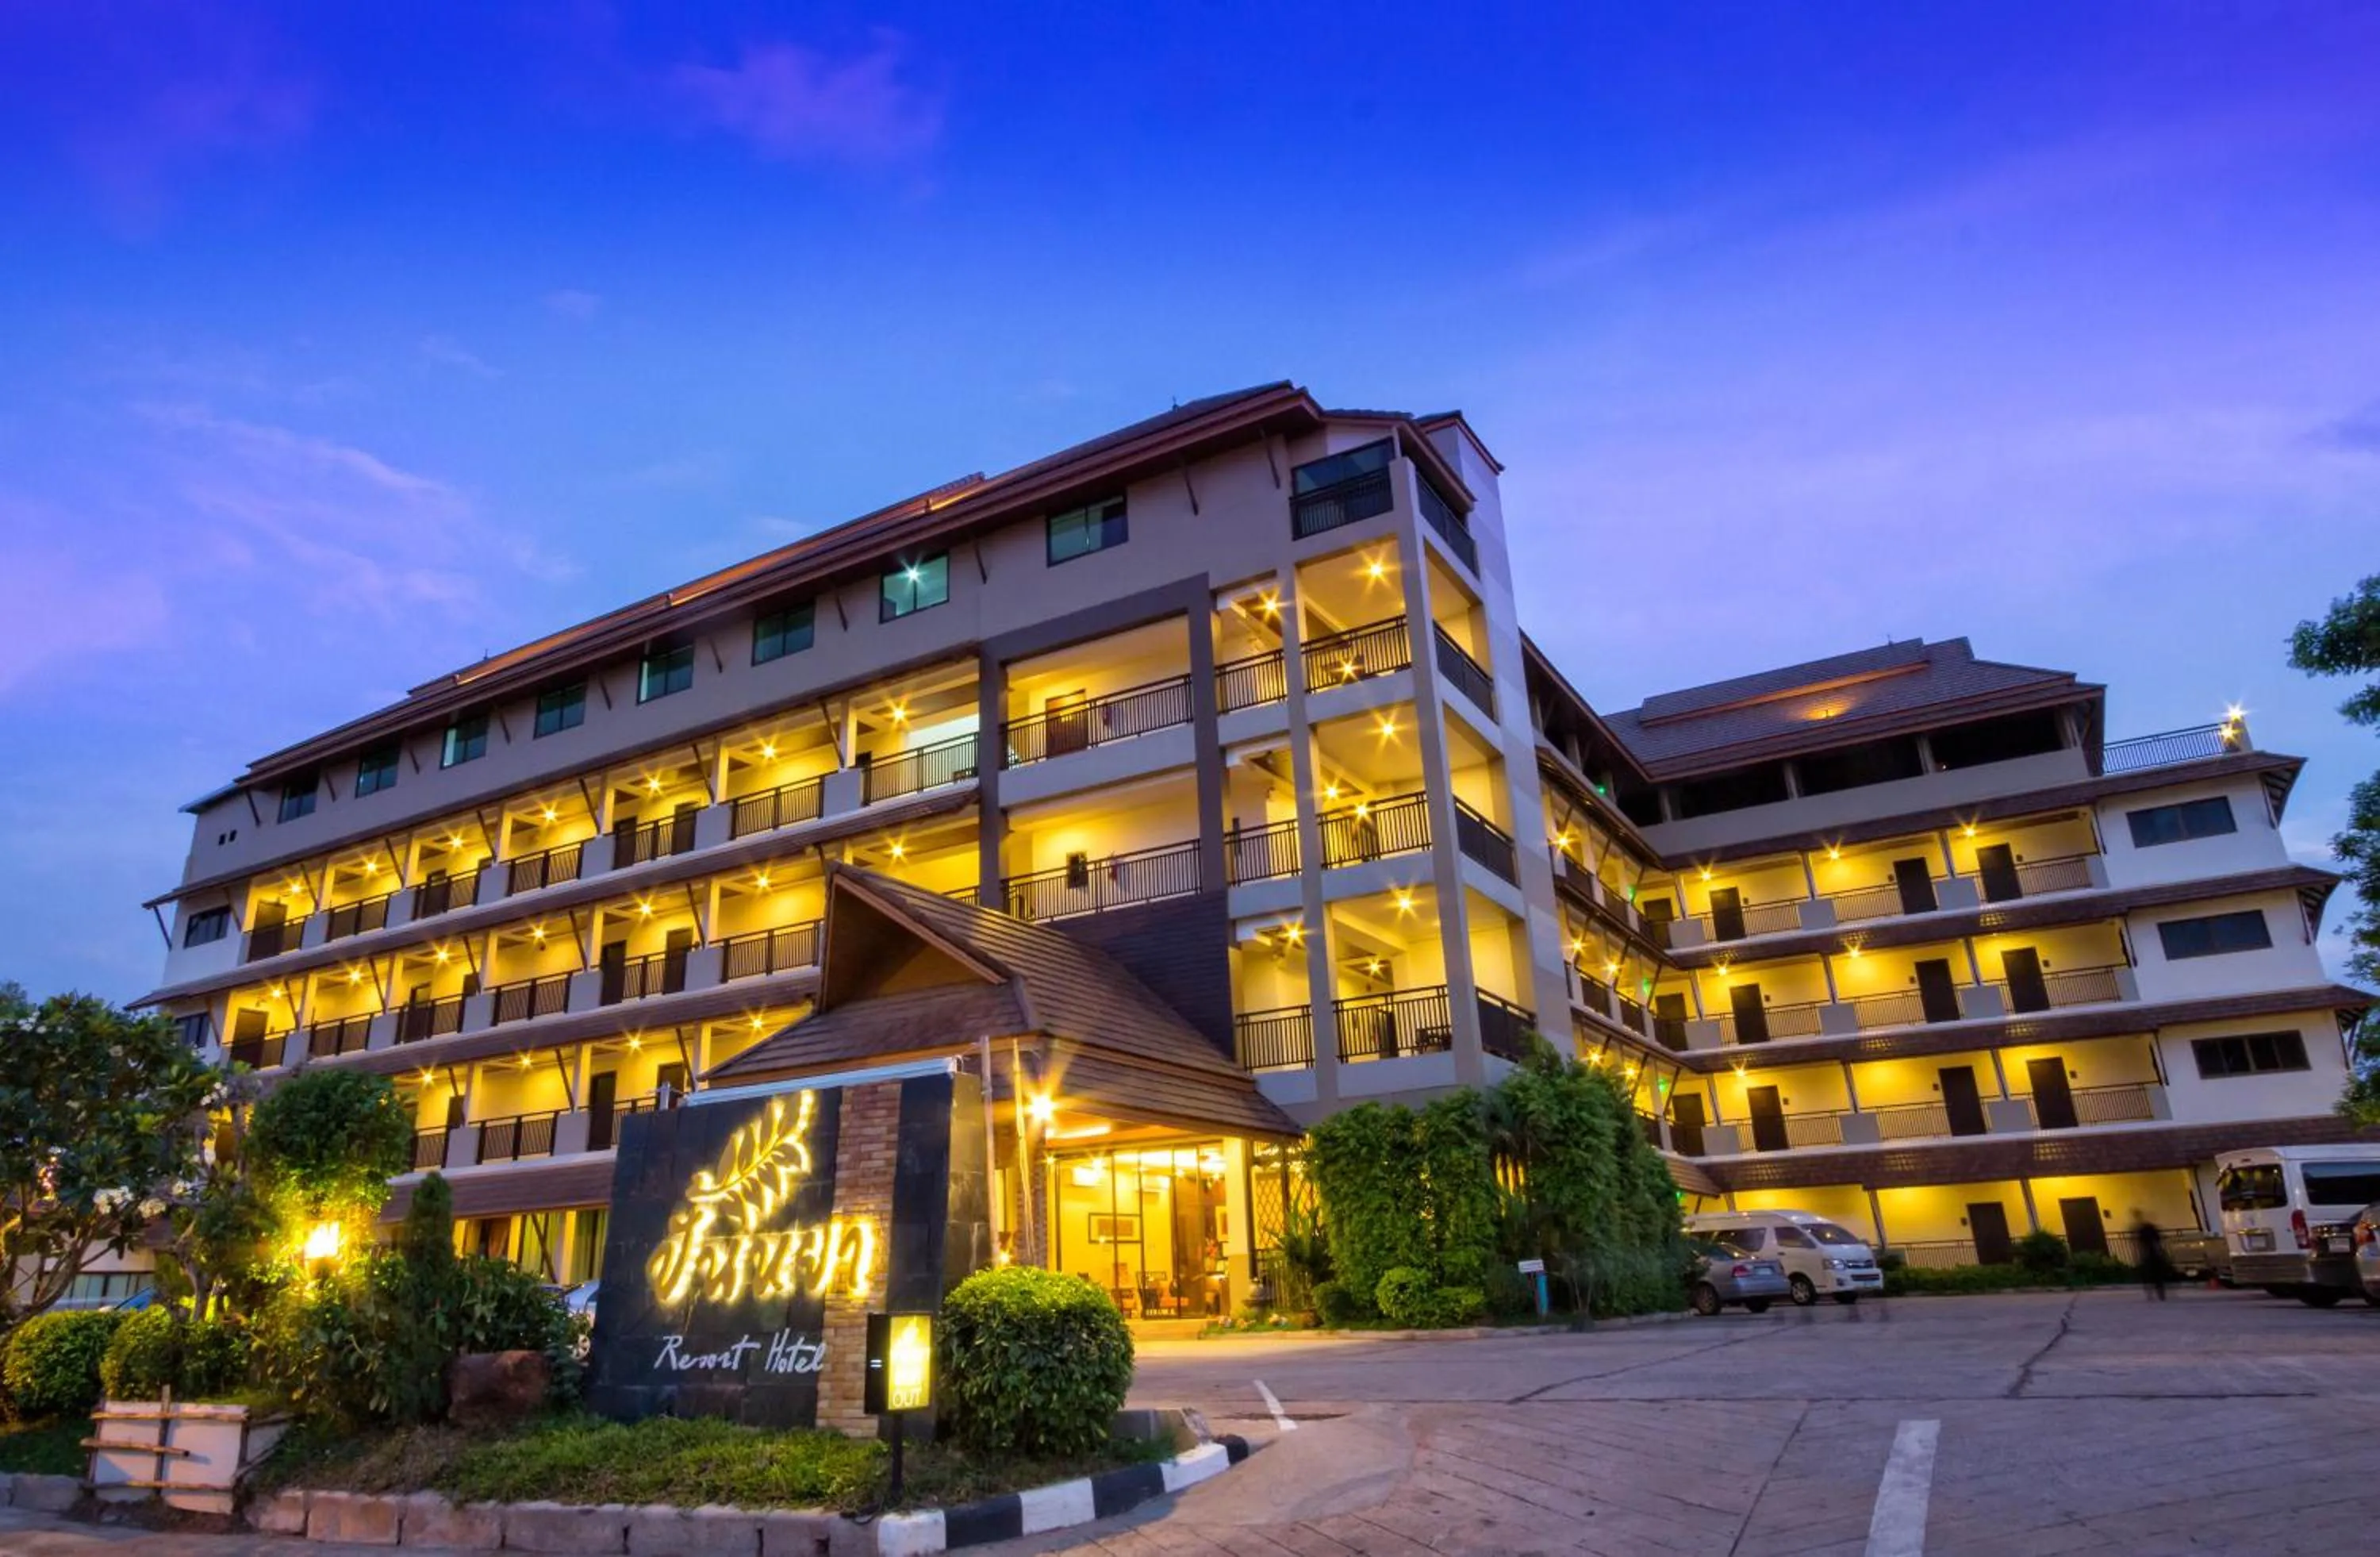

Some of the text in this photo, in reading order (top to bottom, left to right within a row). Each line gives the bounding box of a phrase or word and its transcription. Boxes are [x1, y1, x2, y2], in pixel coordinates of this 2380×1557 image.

[654, 1327, 827, 1373] Resort Hotel
[892, 1386, 922, 1408] OUT
